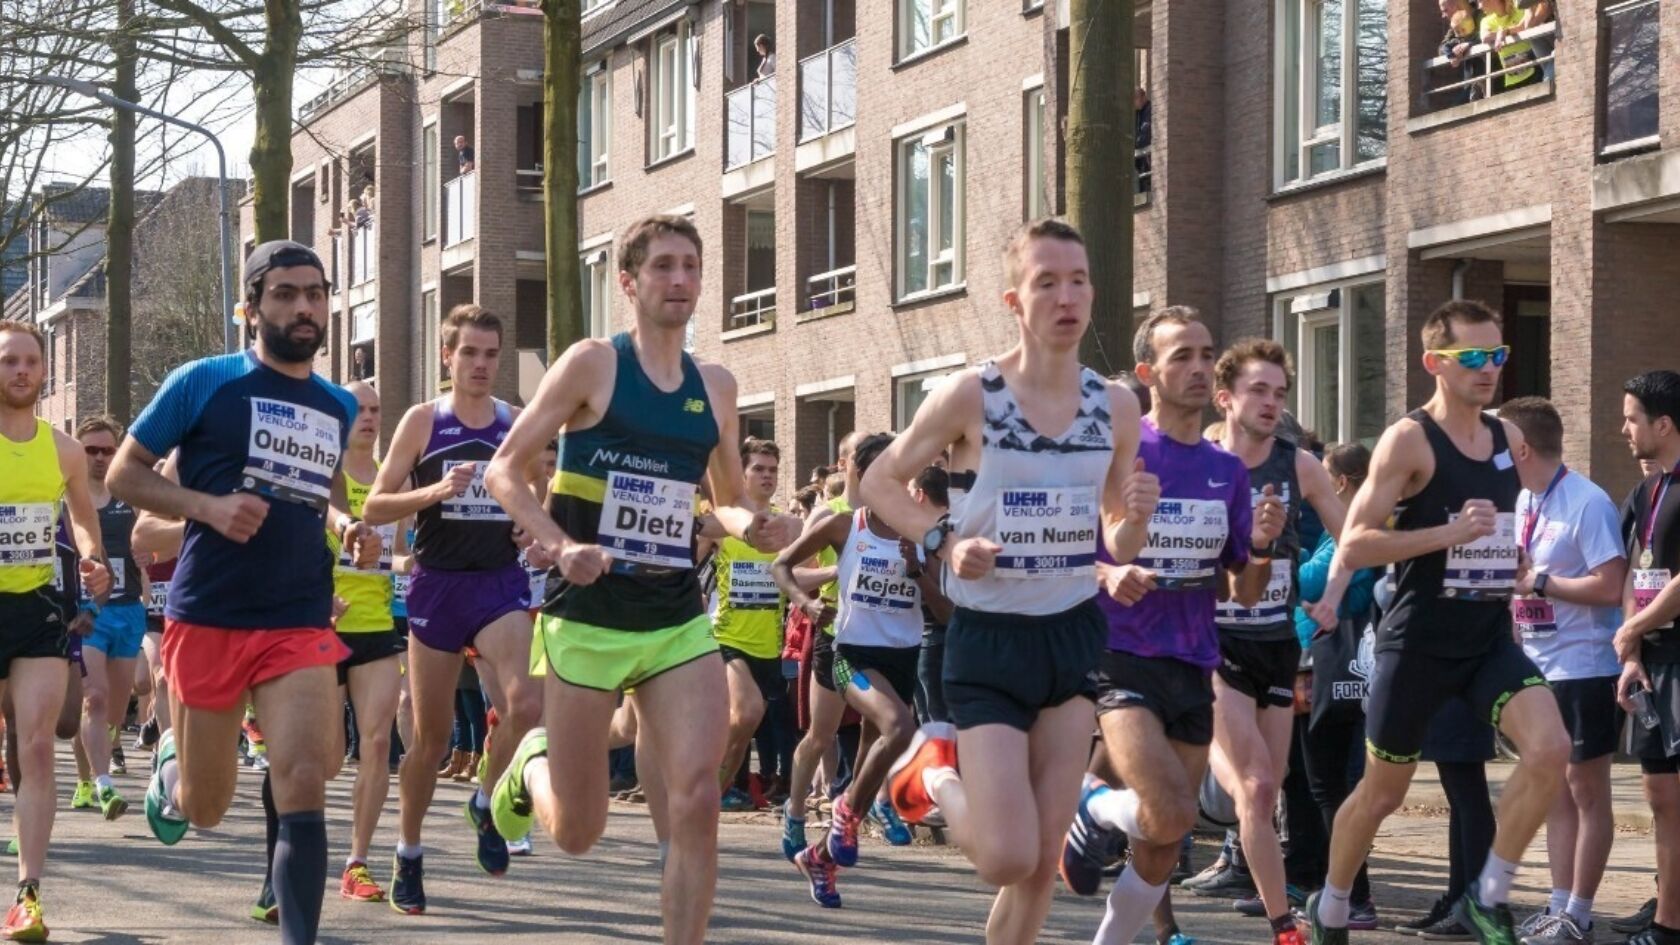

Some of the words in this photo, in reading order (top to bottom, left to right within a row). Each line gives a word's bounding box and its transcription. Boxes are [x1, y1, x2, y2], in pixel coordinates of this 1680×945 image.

[257, 413, 308, 432] VENLOOP
[315, 428, 334, 442] 2018
[1079, 434, 1106, 445] adidas
[254, 429, 337, 468] Oubaha
[262, 460, 274, 472] M
[287, 466, 300, 479] 34
[621, 454, 669, 474] AlbWert
[453, 504, 461, 512] M
[612, 489, 666, 506] VENLOOP
[673, 499, 690, 510] 2018
[1003, 506, 1062, 518] VENLOOP
[1070, 505, 1090, 516] 2018
[615, 505, 684, 539] Dietz
[1203, 516, 1222, 526] 2018
[43, 526, 52, 543] 5
[1000, 530, 1035, 544] van
[1042, 527, 1094, 543] Nunen
[613, 538, 625, 549] M
[644, 543, 658, 554] 19
[861, 565, 897, 576] VENLOOP
[1013, 557, 1025, 568] M
[1034, 557, 1068, 568] 30011
[1153, 559, 1164, 569] M
[1459, 570, 1469, 579] M
[1483, 570, 1494, 579] 21
[856, 574, 916, 597] Kejeta
[1332, 681, 1371, 700] FORK
